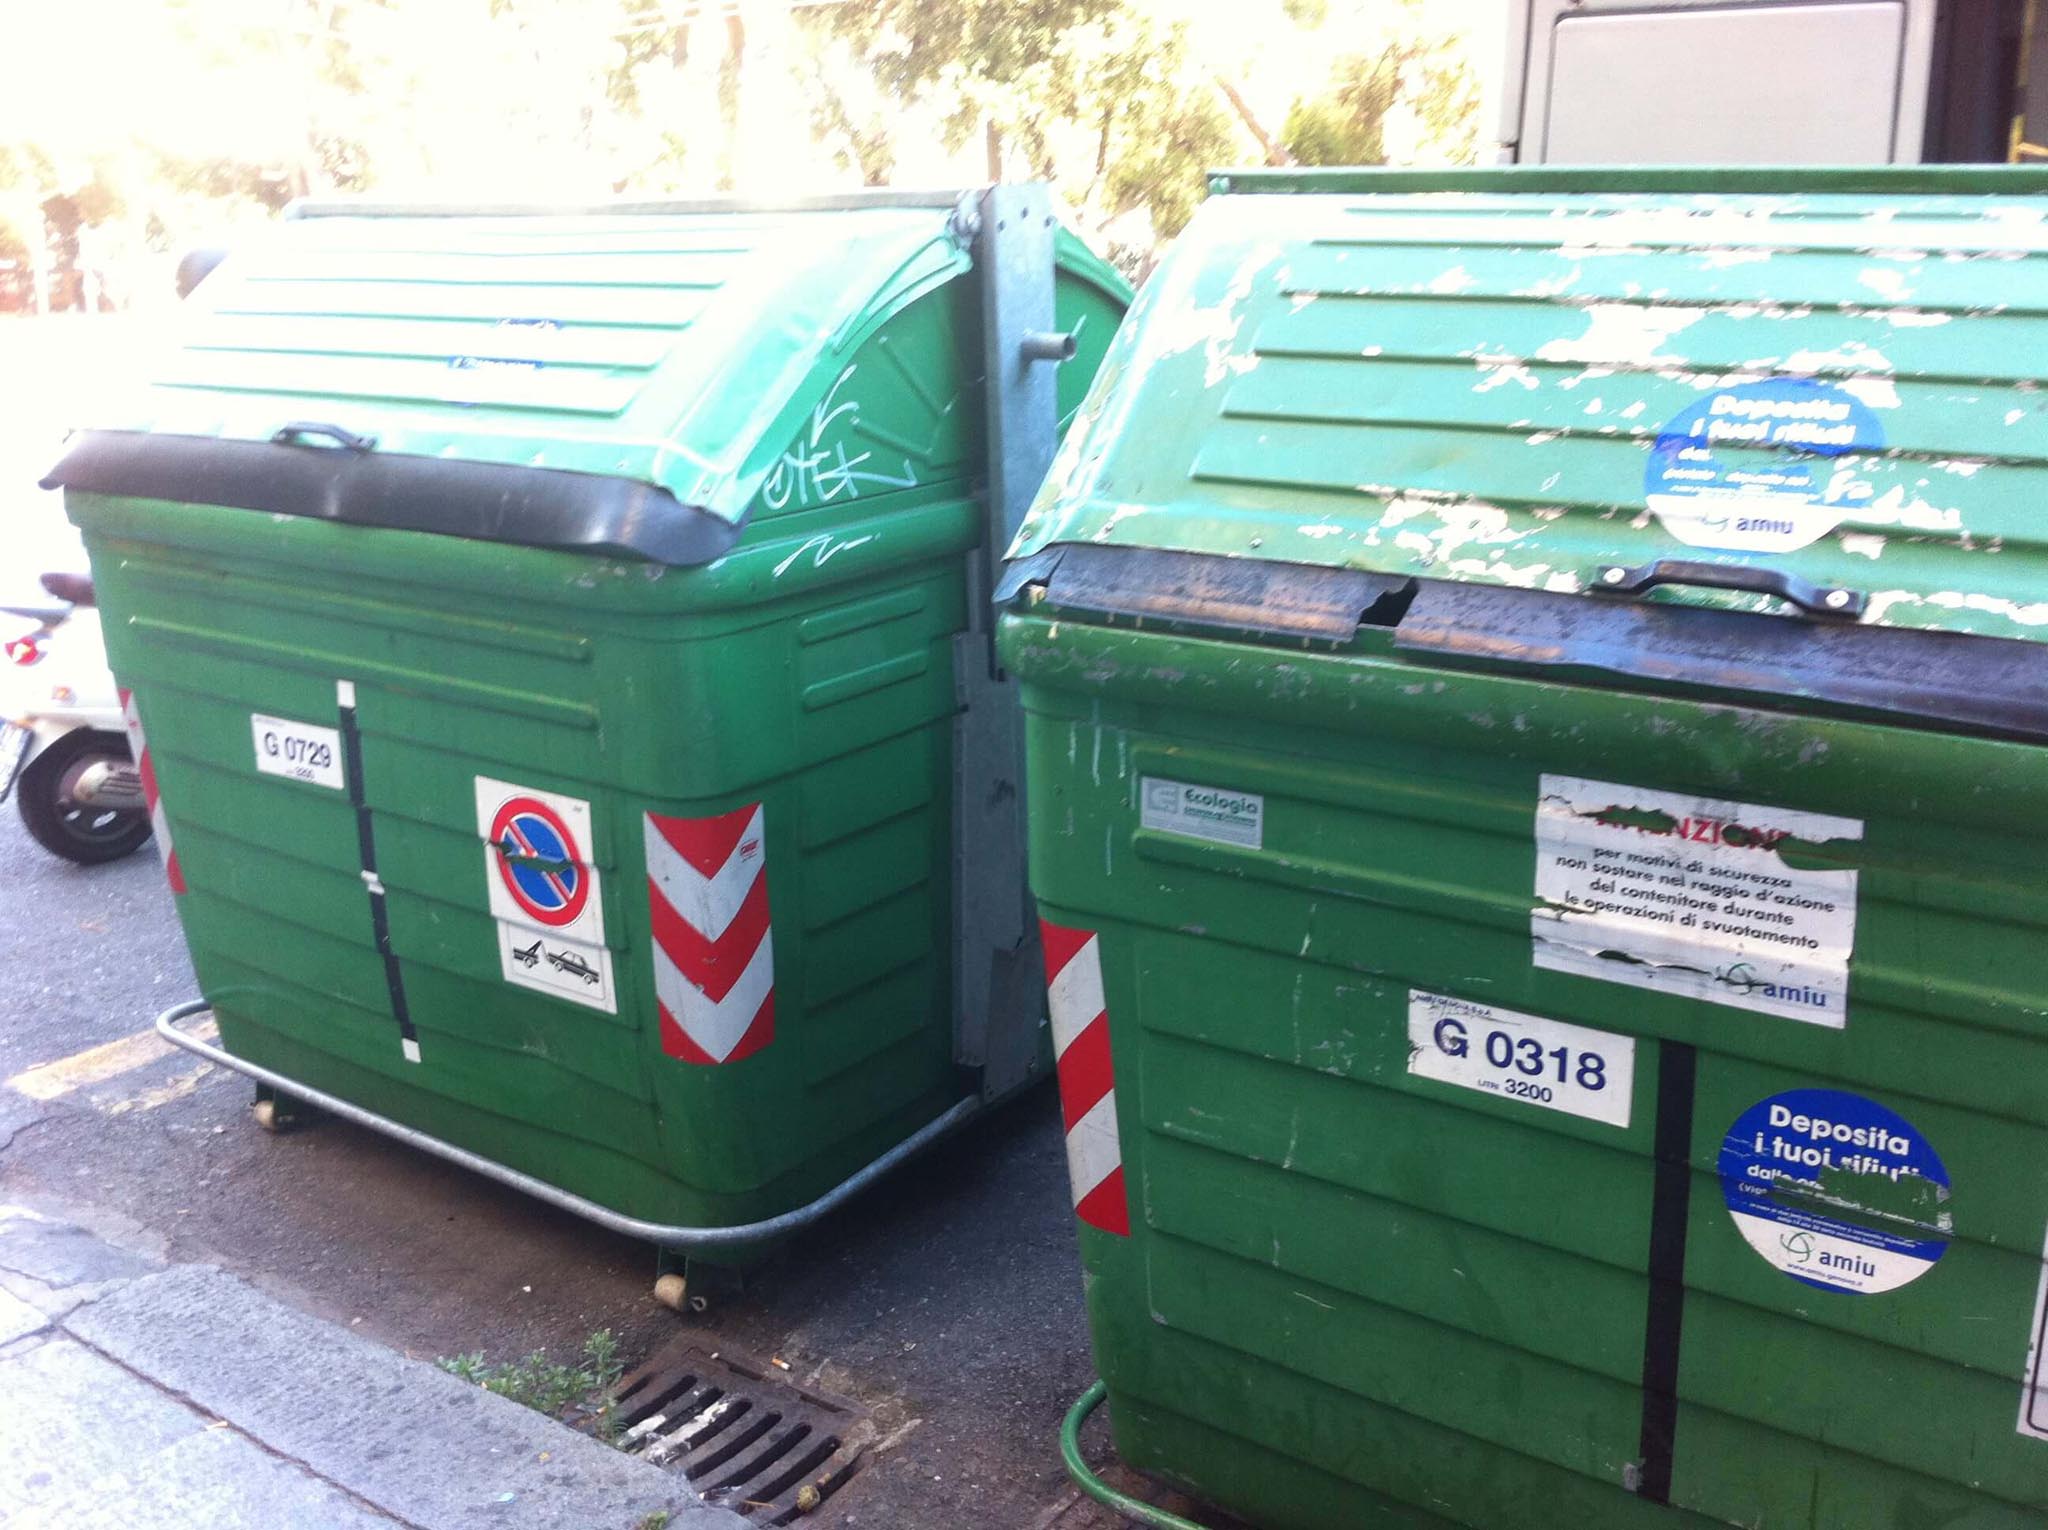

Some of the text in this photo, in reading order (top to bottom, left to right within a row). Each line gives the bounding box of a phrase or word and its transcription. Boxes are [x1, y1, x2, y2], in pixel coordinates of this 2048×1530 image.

[1736, 516, 1794, 534] amiu
[264, 731, 331, 769] G 0729
[1184, 788, 1258, 813] Ecologia
[1556, 856, 1588, 870] non
[1593, 862, 1654, 881] sostare
[1659, 873, 1686, 888] nel
[1691, 880, 1750, 899] raggio
[1593, 848, 1792, 888] per motivi di sicurezza
[1564, 890, 1819, 949] le operazioni di svuotamento
[1590, 878, 1795, 926] del contenitore durante
[1763, 982, 1826, 1007] amiu
[1433, 1018, 1606, 1092] G 0318
[1504, 1078, 1553, 1103] 3200
[1769, 1104, 1910, 1156] Deposita
[1755, 1132, 1764, 1153] i
[1772, 1136, 1831, 1167] tuoi
[1819, 1251, 1875, 1278] amiu
